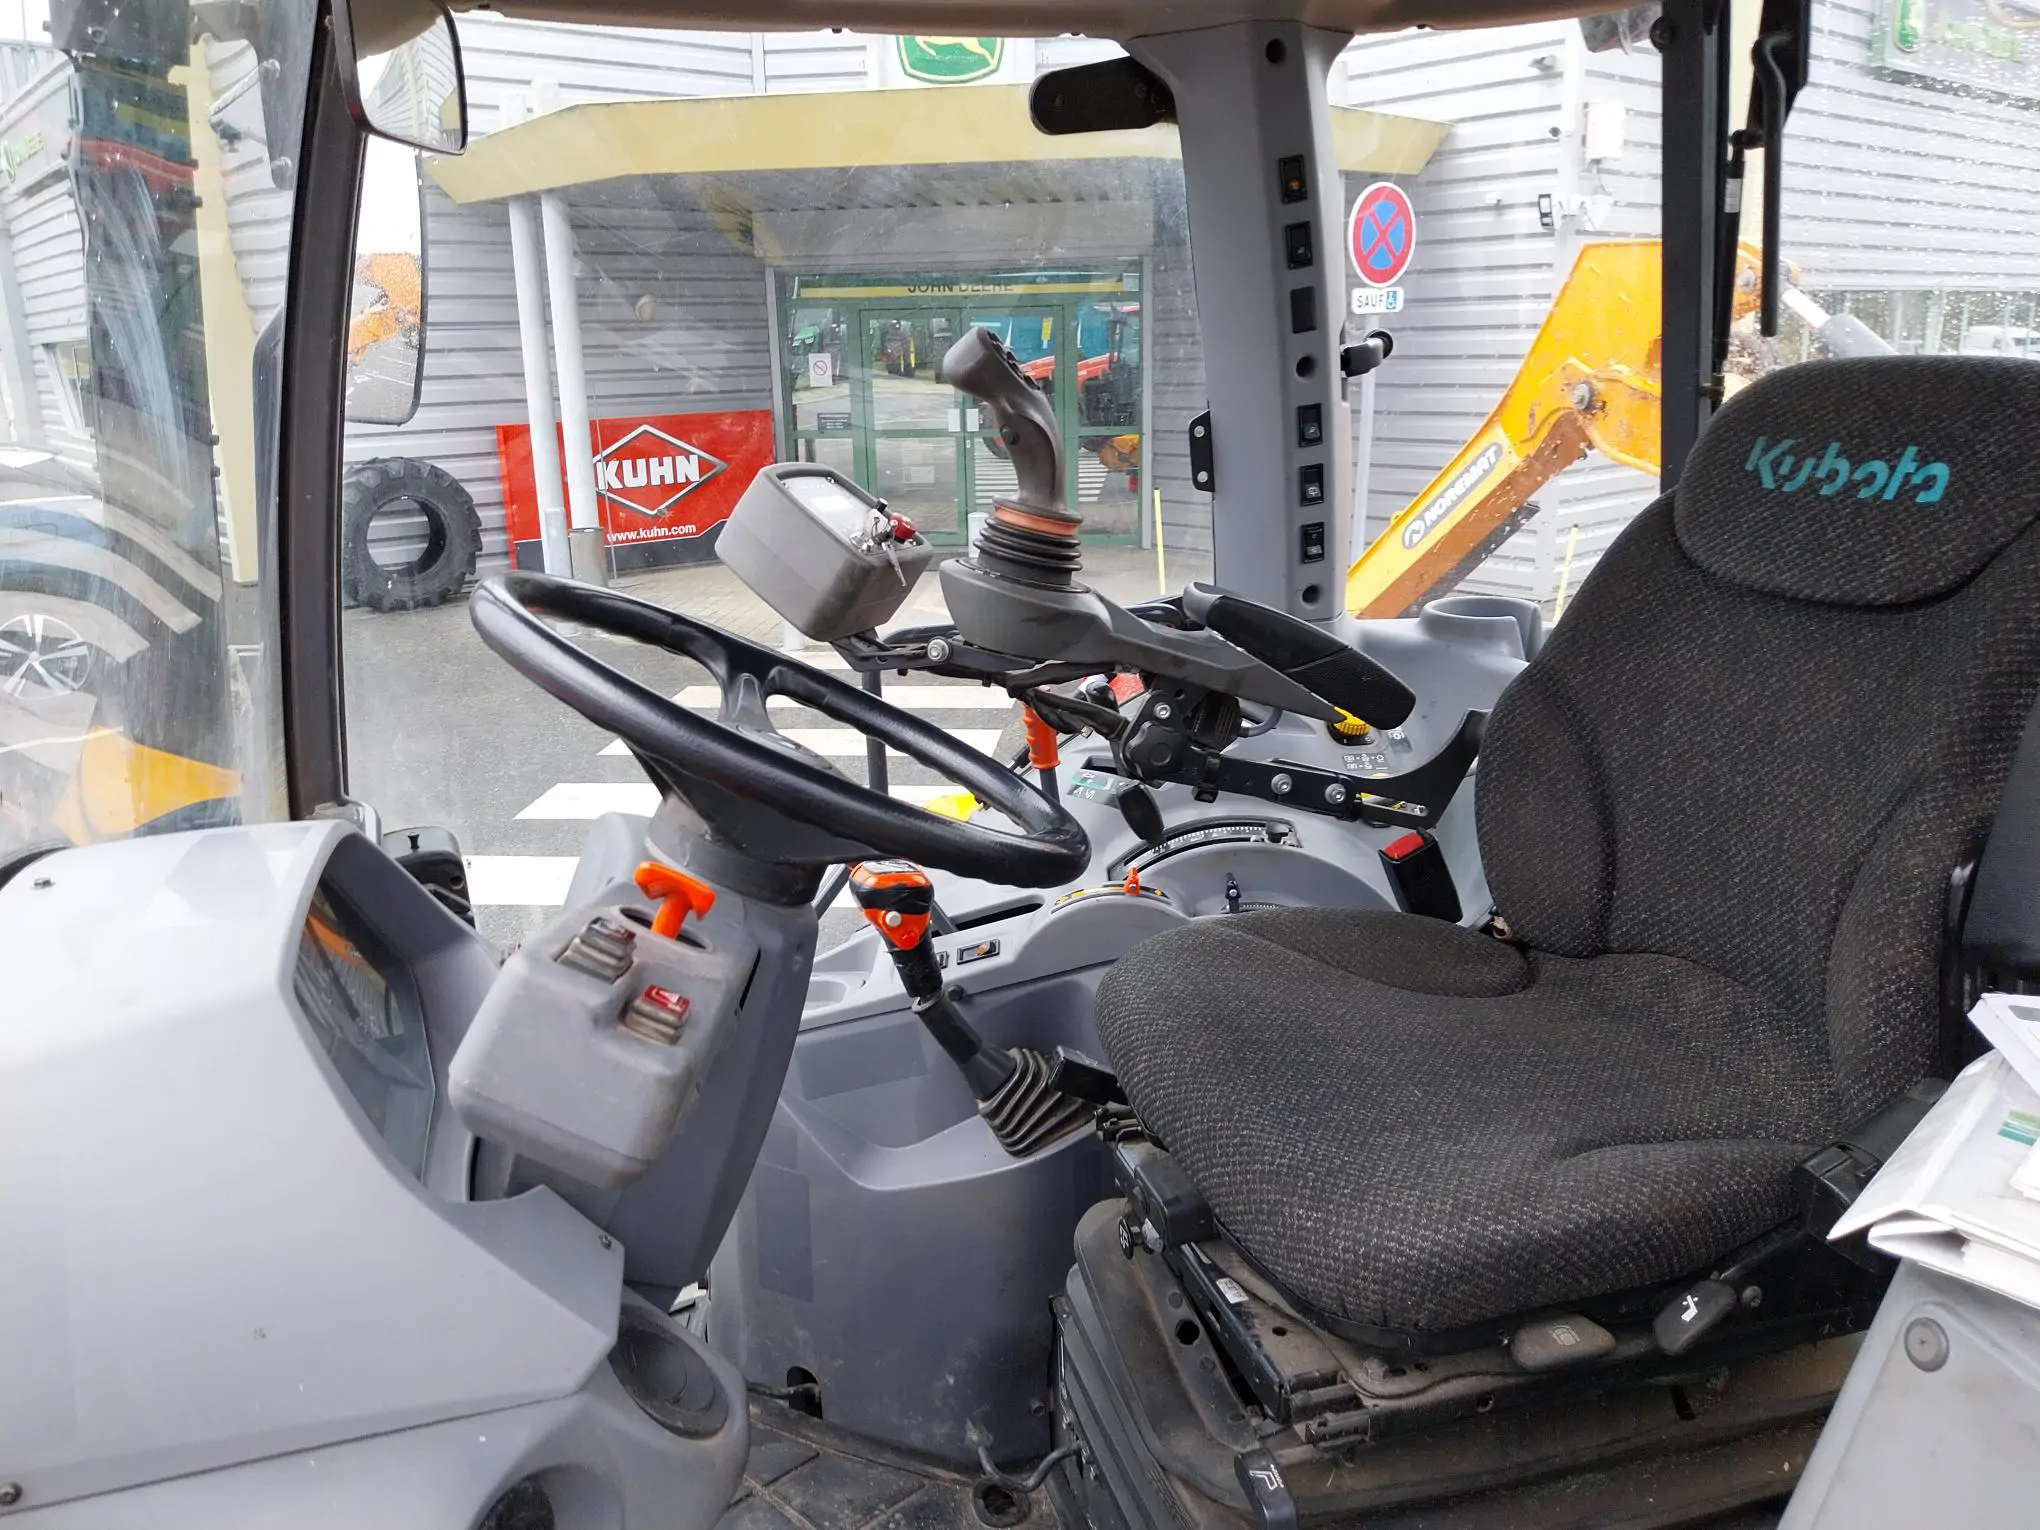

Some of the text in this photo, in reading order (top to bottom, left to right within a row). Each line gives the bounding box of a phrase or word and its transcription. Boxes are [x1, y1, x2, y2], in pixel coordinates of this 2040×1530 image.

[1357, 294, 1384, 308] SAUF
[596, 454, 700, 490] KUHN
[1424, 445, 1497, 526] NOREMAT
[1745, 436, 1950, 504] Kubota
[607, 524, 696, 542] www.kuhn.com
